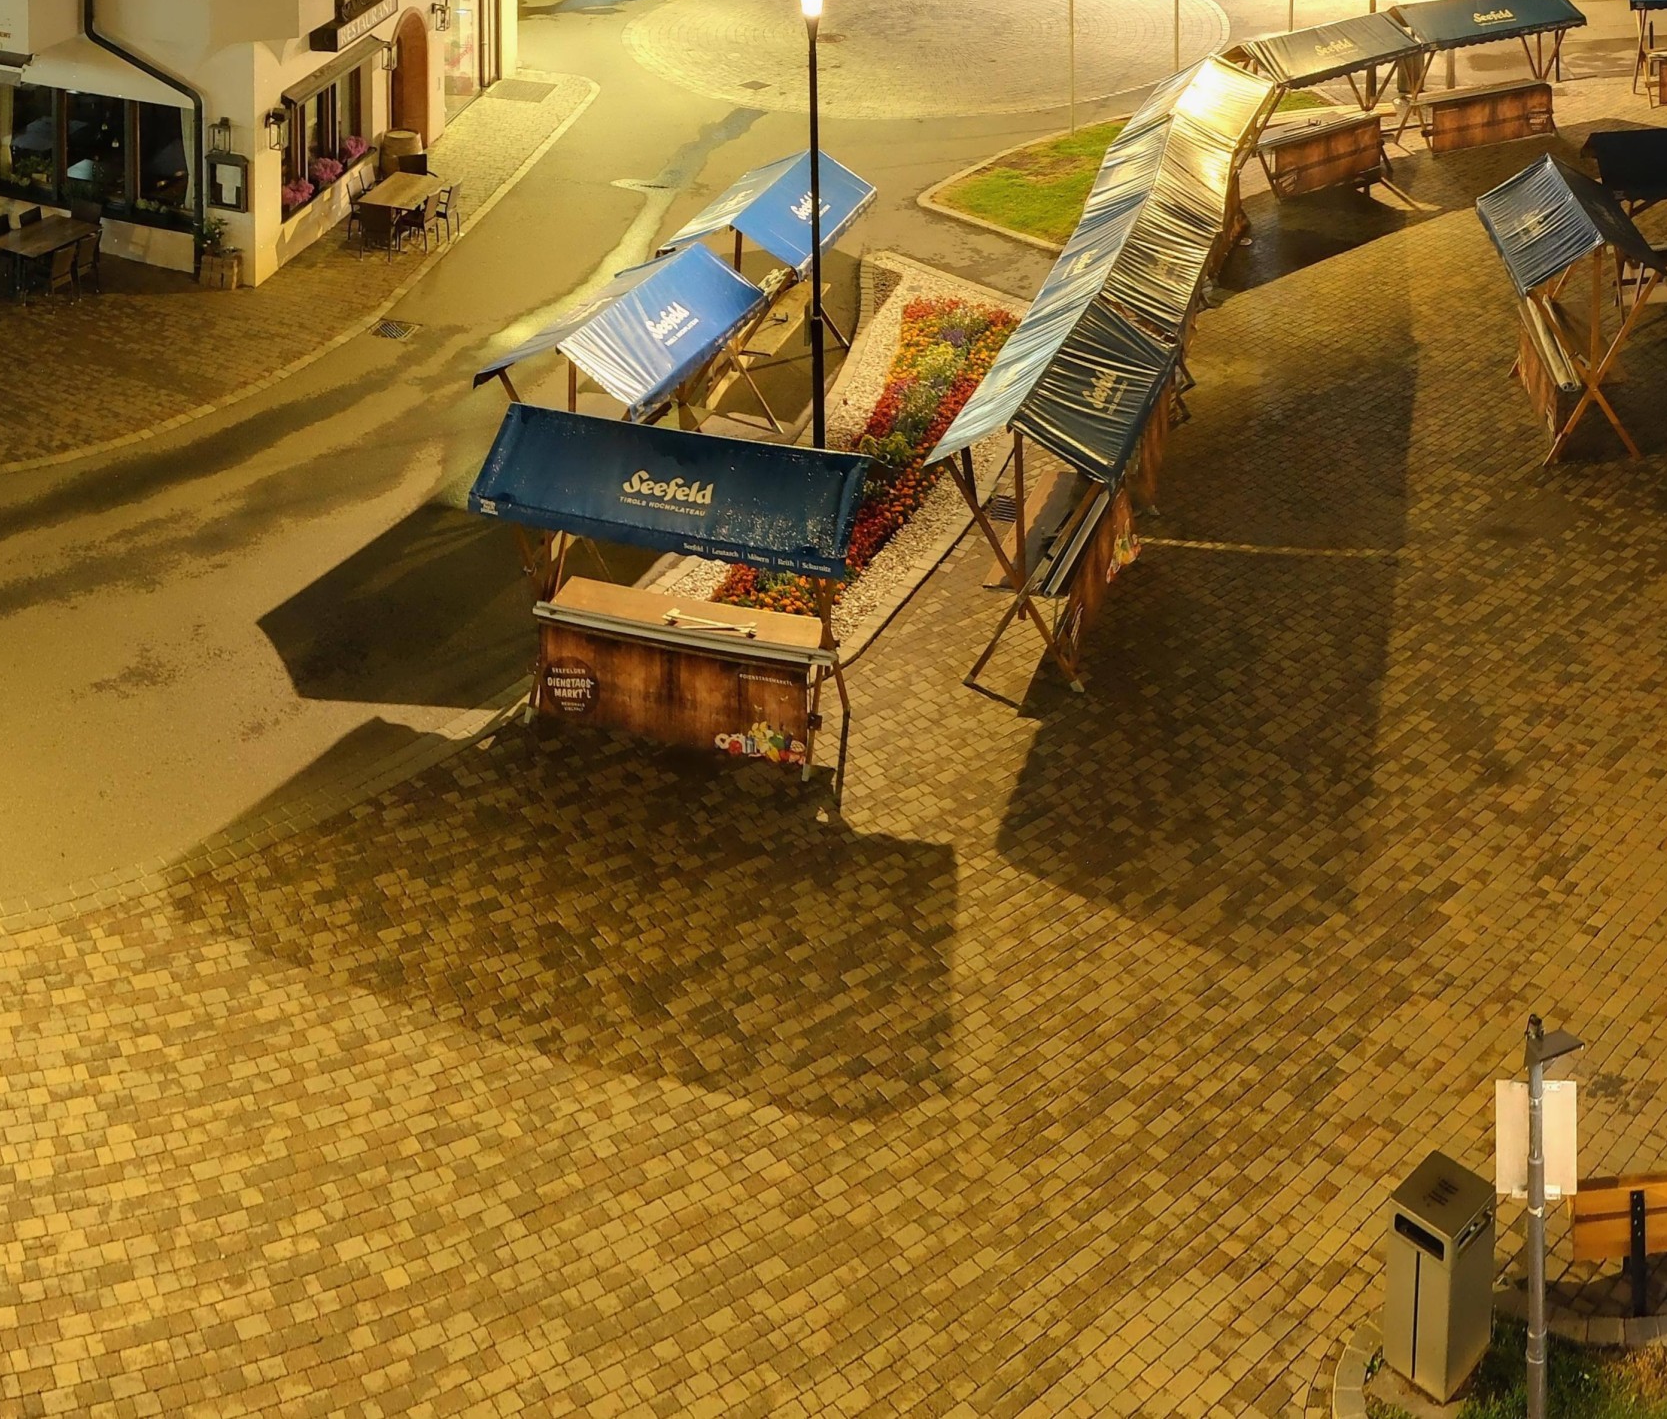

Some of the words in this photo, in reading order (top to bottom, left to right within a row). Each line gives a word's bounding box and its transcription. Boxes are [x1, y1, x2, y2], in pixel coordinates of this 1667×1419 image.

[1473, 8, 1514, 23] Seefeld
[645, 301, 690, 341] Seefeld
[622, 470, 714, 505] Seefeld
[619, 496, 648, 507] TIROLS
[648, 501, 706, 517] HOCHPLATEAU
[547, 676, 595, 688] DIENSTAGS-
